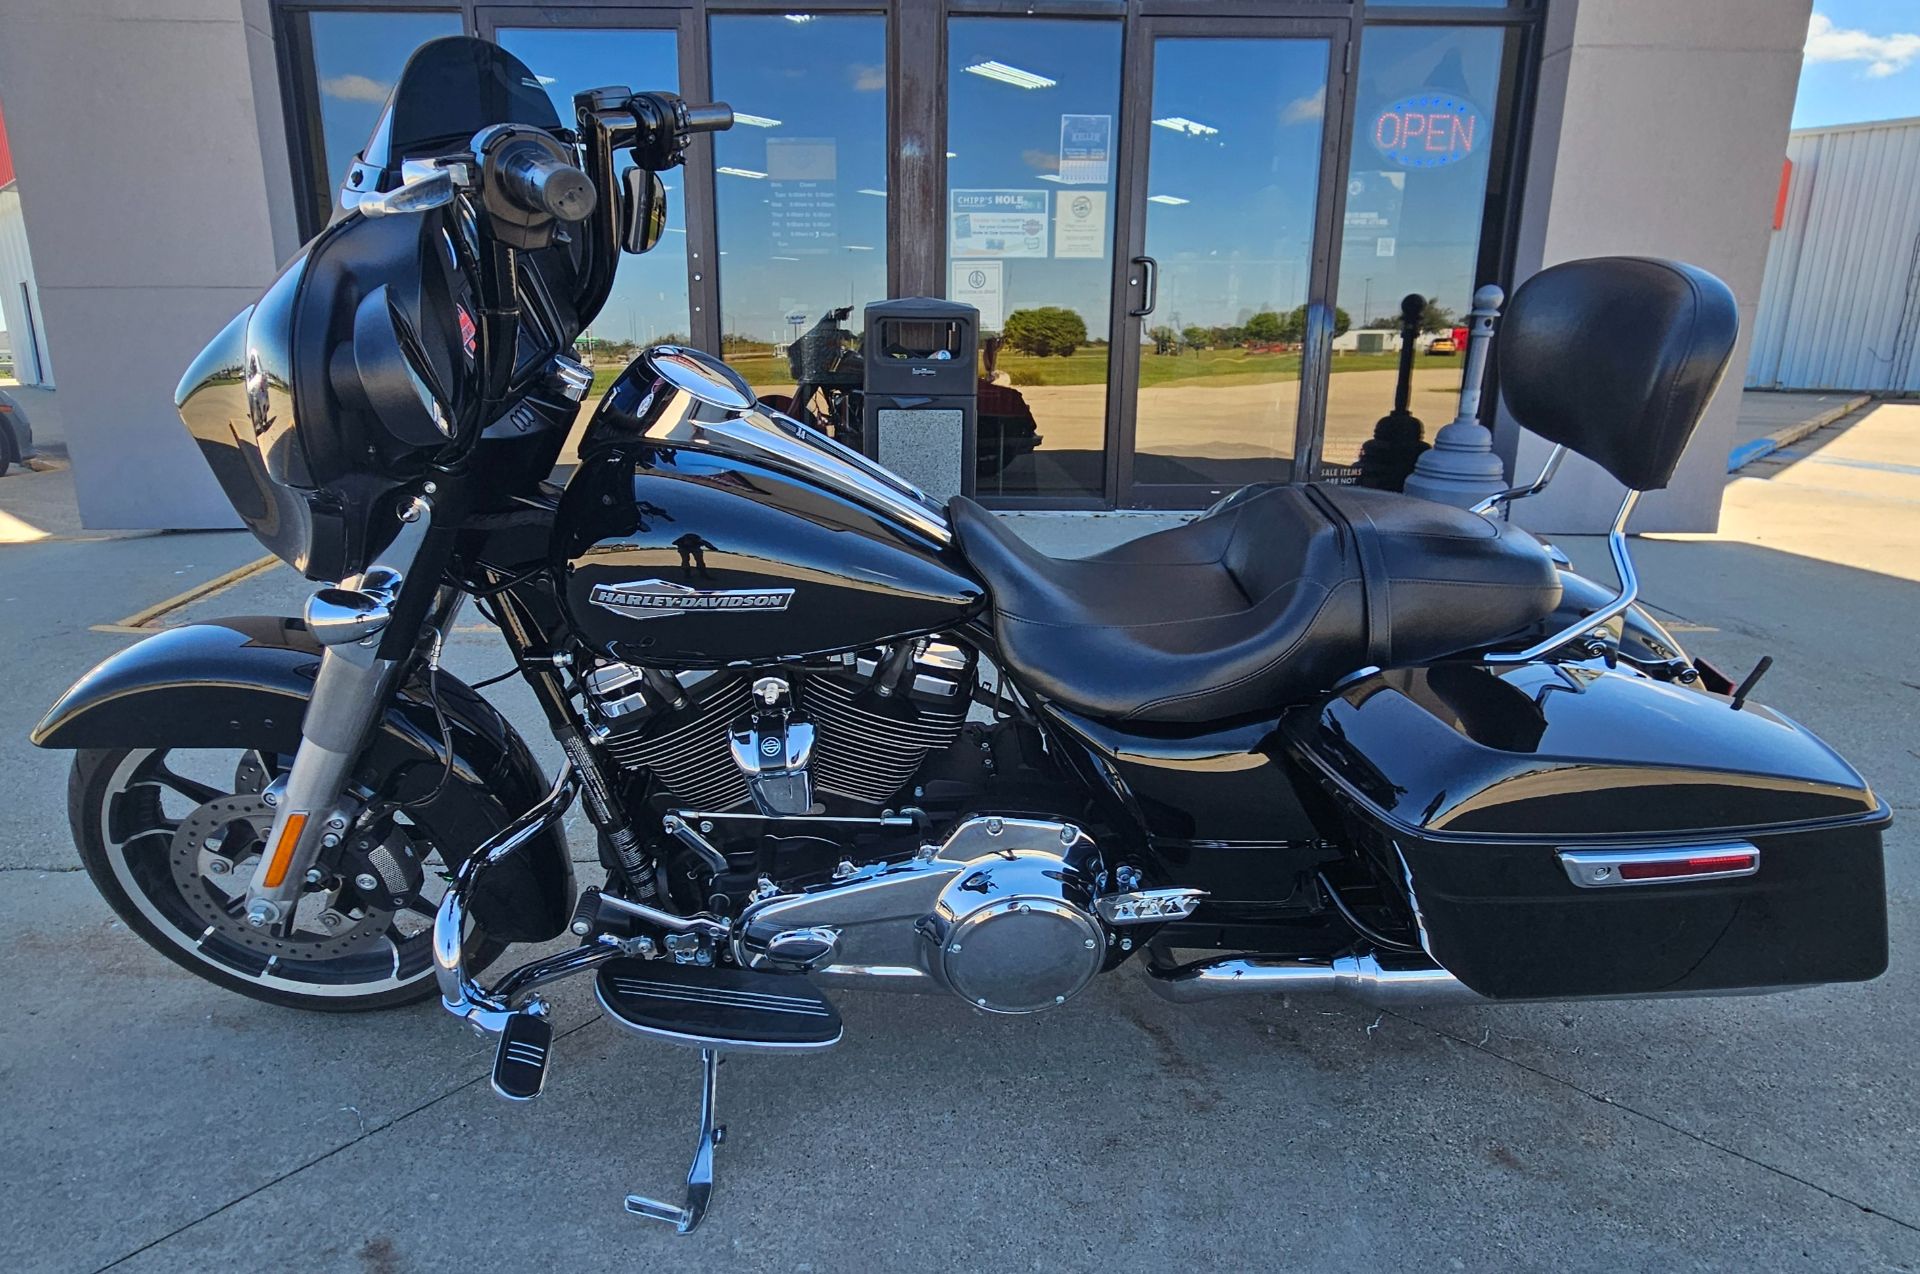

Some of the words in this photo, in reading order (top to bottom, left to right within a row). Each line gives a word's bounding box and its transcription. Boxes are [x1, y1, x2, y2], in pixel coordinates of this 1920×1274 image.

[1376, 112, 1475, 152] OPEN
[1321, 468, 1338, 477] SALE
[1340, 468, 1363, 477] ITEMS
[599, 591, 784, 609] HARLEY-DAVIDSON
